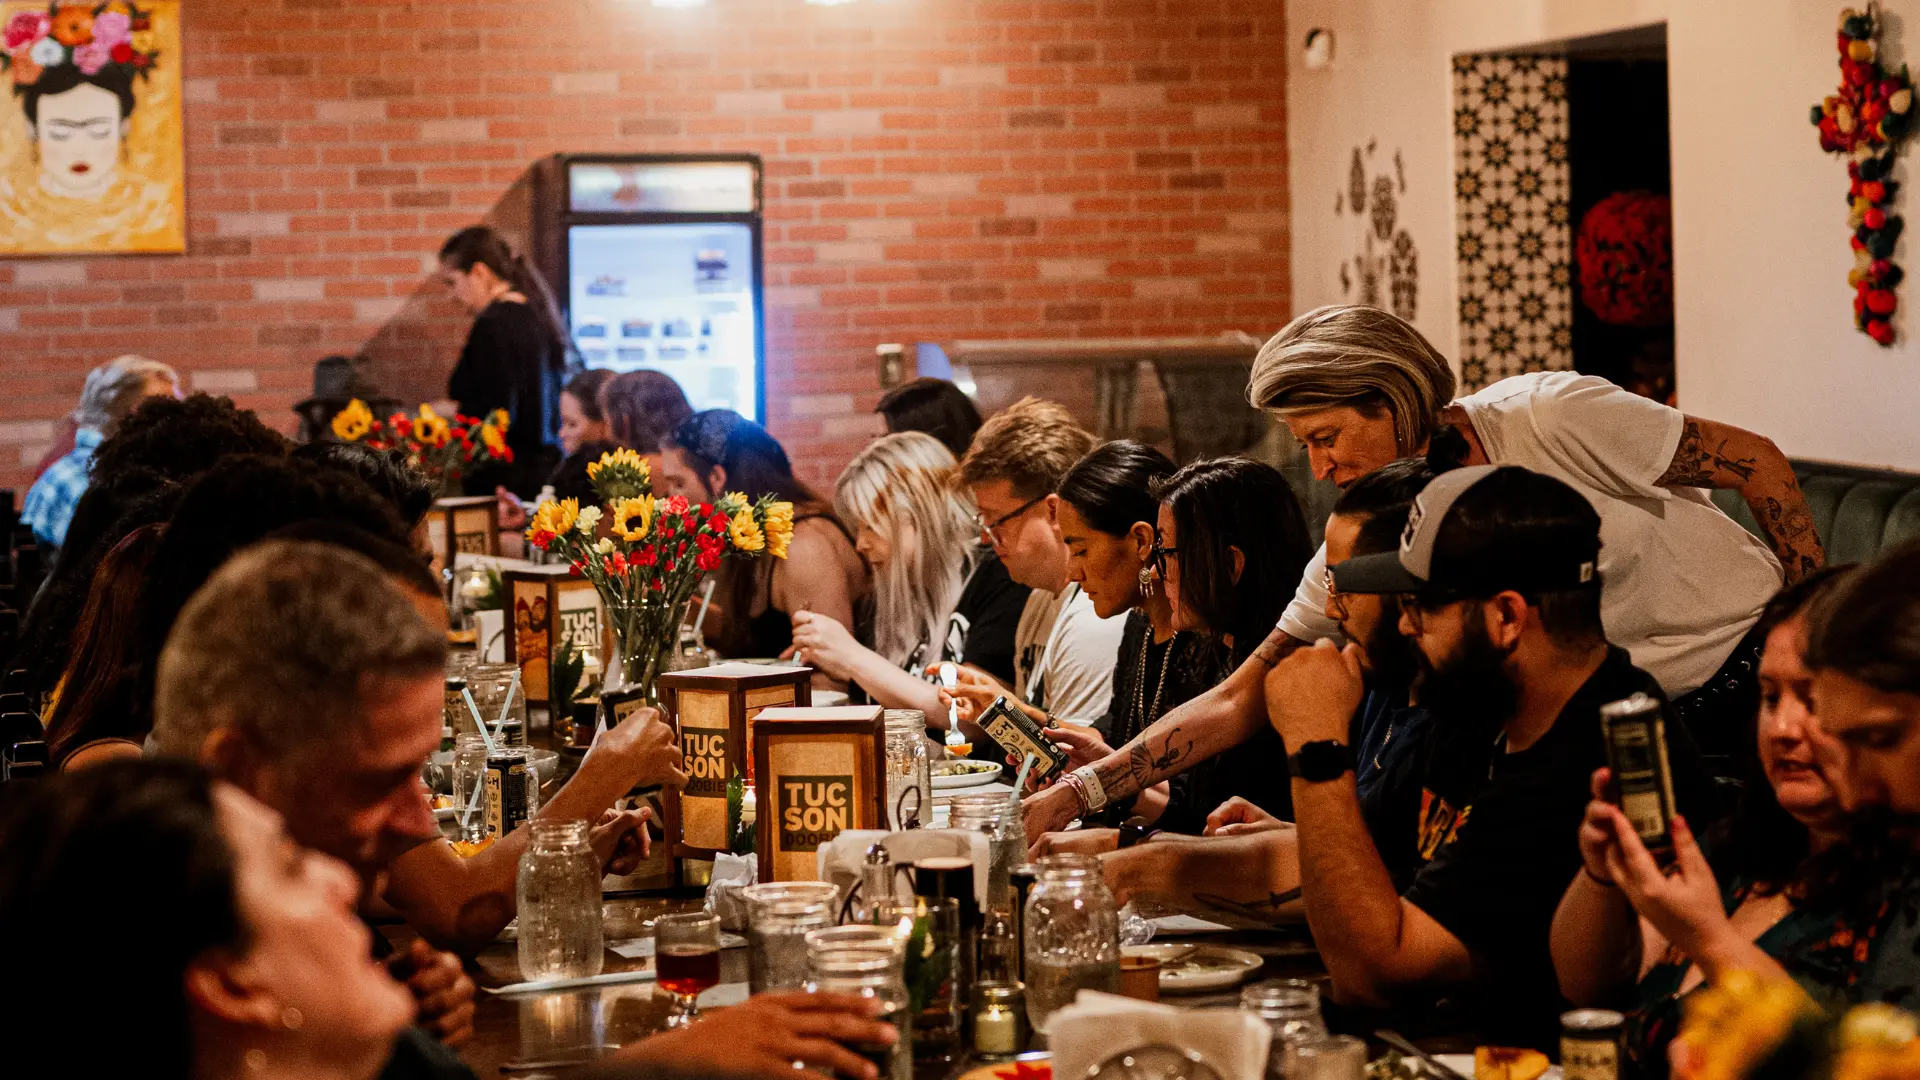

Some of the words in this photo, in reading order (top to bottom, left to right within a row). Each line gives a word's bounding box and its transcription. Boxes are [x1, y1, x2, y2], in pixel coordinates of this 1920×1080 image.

[560, 611, 595, 630] TUC
[683, 733, 725, 757] TUC
[684, 755, 725, 779] SON
[784, 782, 847, 807] TUC
[784, 806, 847, 832] SON
